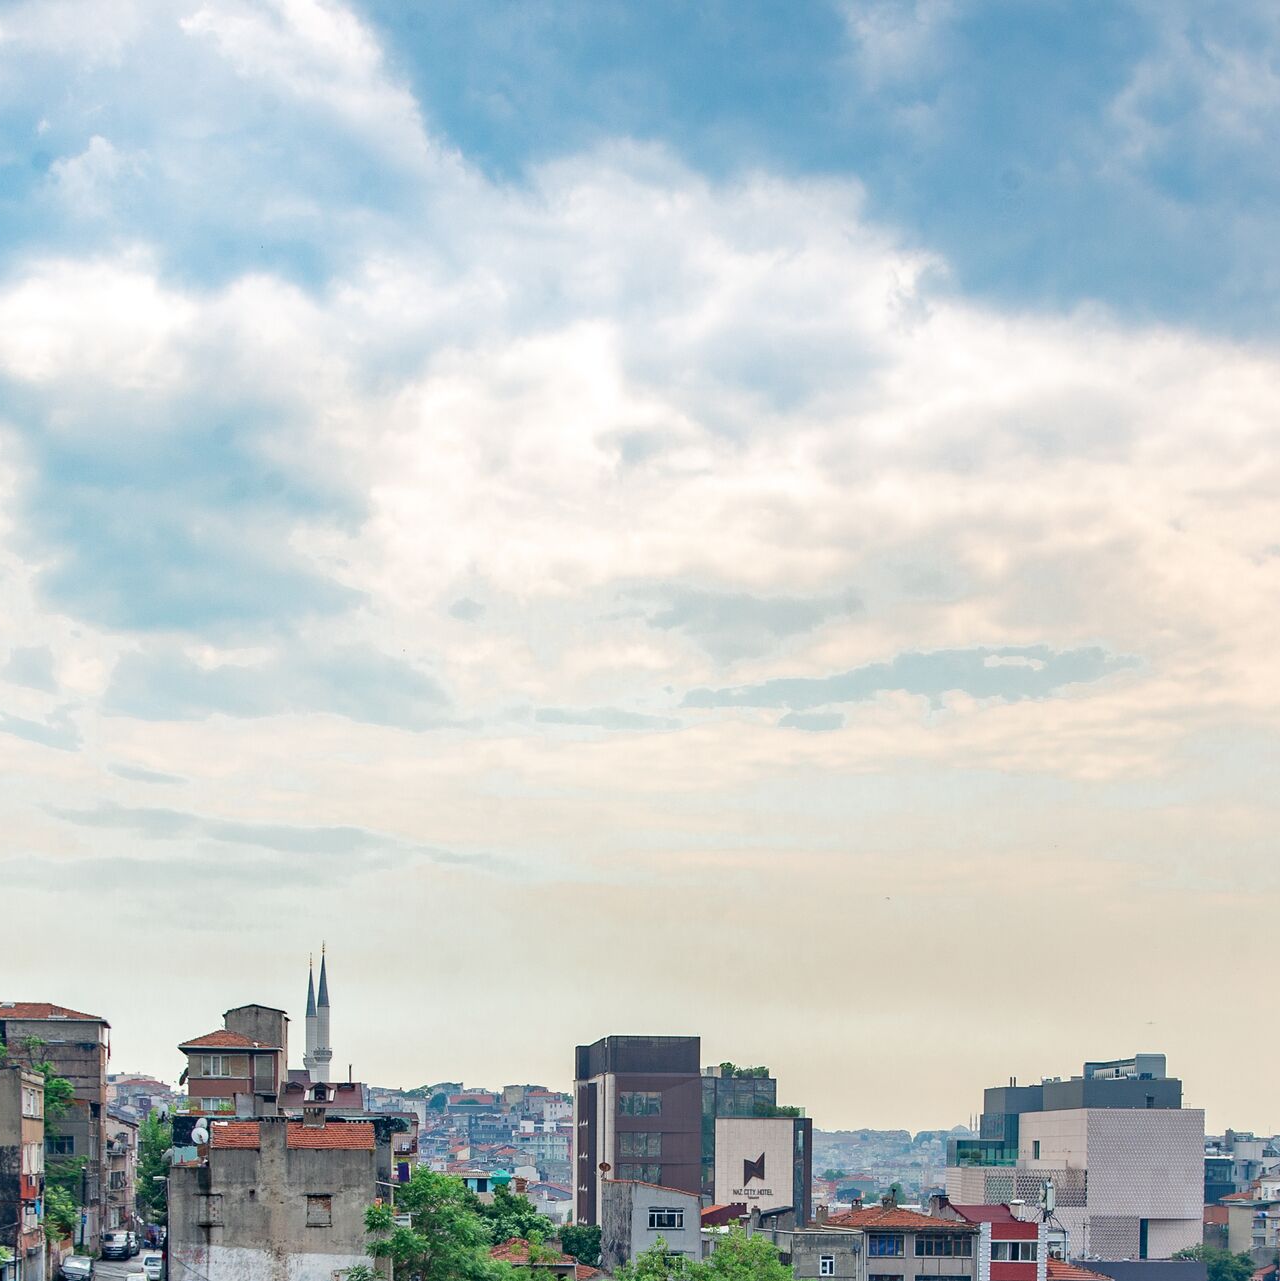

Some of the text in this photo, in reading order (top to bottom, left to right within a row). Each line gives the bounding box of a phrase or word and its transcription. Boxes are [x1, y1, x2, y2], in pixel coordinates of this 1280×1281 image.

[733, 1188, 774, 1196] NAZ CITY HOTEL
